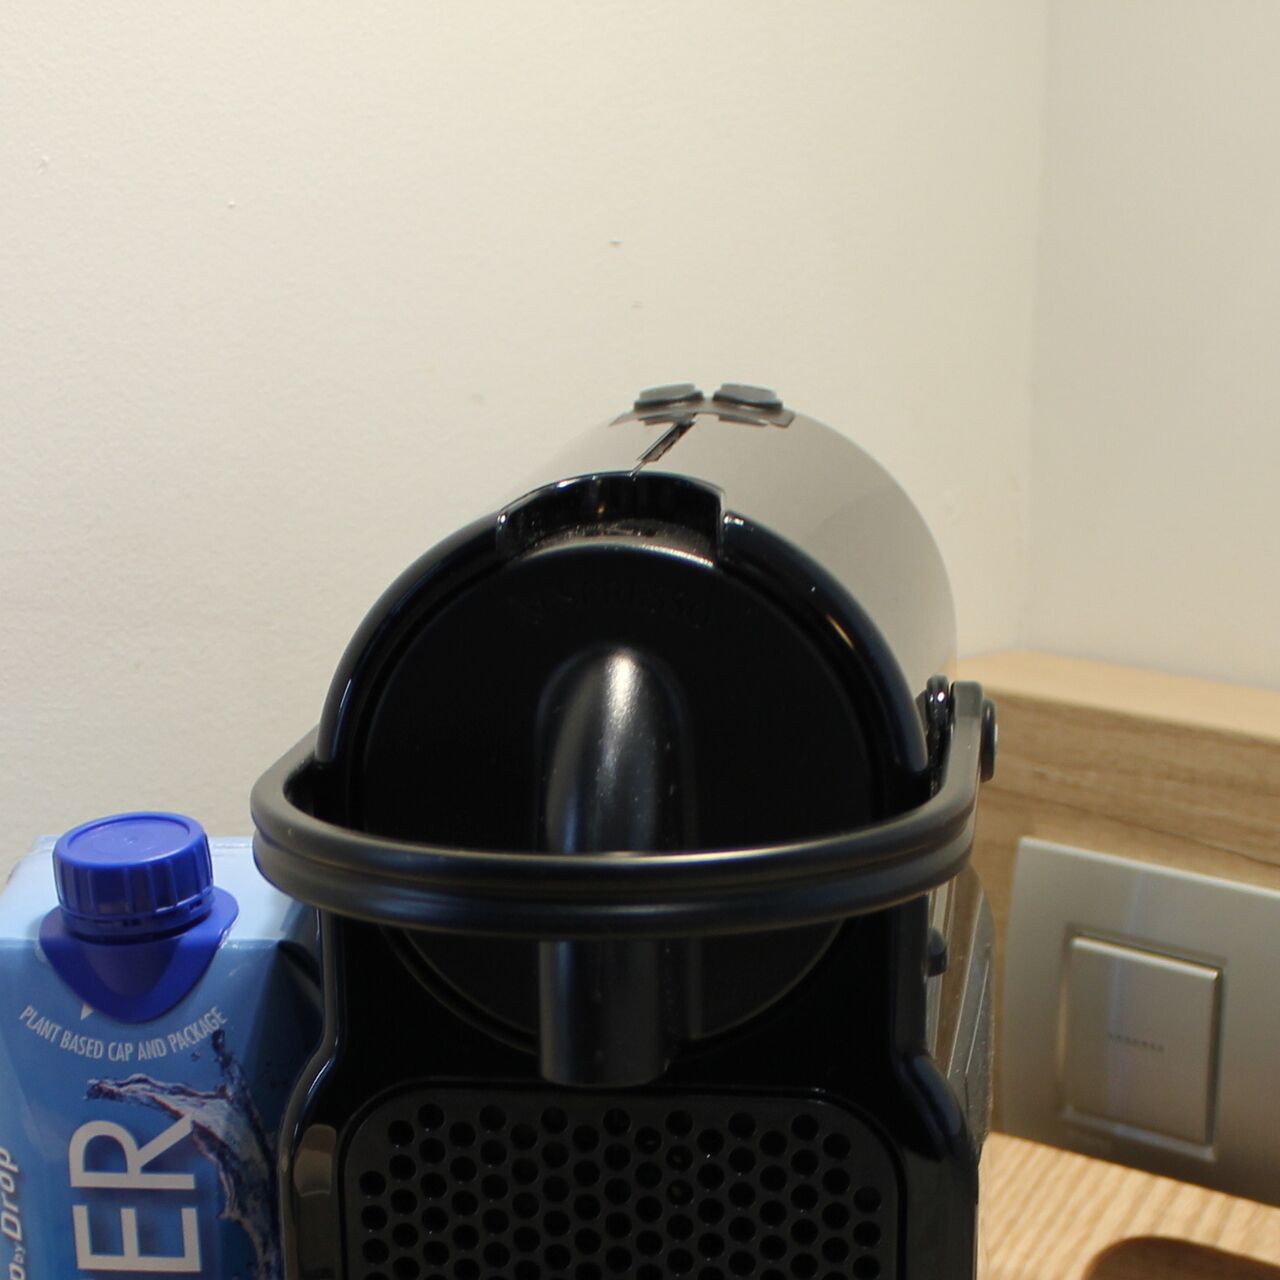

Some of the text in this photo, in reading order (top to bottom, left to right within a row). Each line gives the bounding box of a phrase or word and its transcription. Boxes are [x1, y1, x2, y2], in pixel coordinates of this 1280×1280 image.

[20, 1004, 229, 1062] PLANT BASED CAP AND PACKAGE
